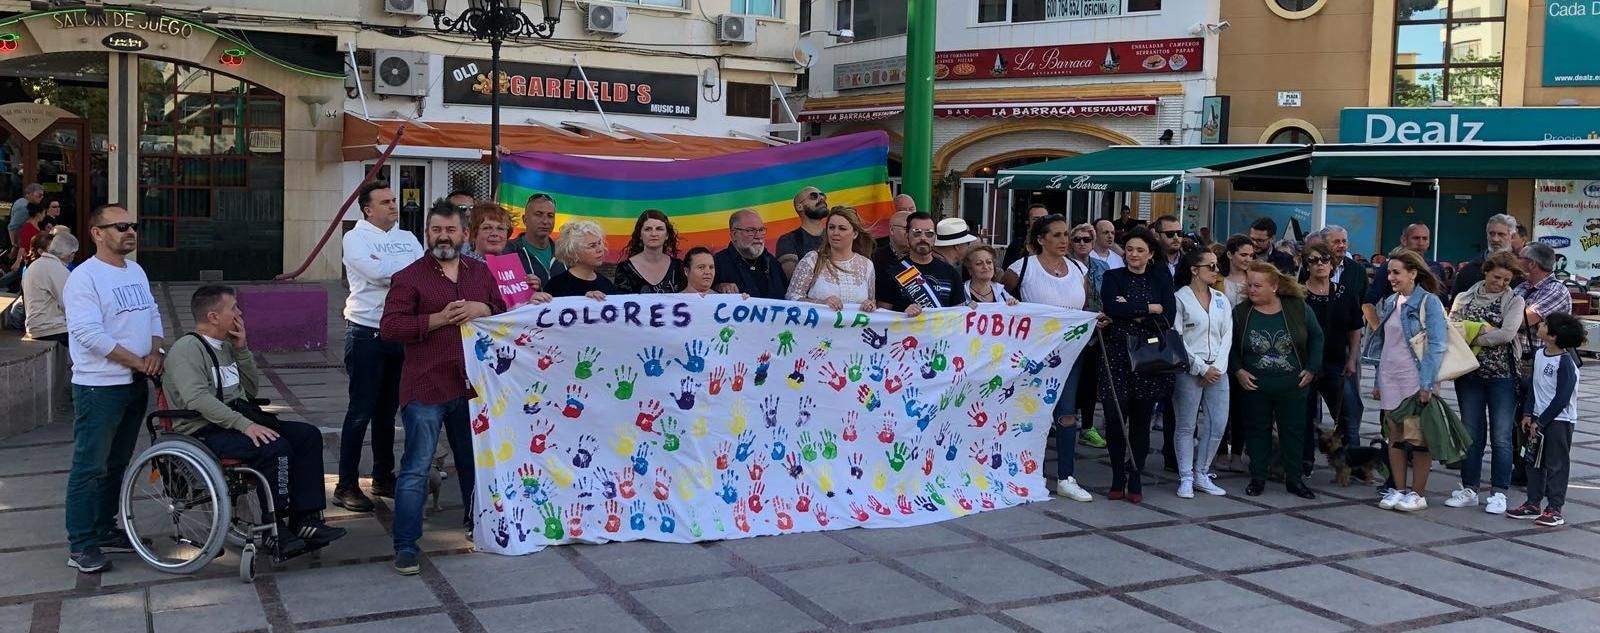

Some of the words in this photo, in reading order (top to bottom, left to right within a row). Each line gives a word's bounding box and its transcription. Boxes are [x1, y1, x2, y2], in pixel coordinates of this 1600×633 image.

[1083, 3, 1108, 16] OFICINA
[1549, 2, 1586, 17] Cada
[114, 12, 135, 28] DE
[139, 16, 193, 39] JUEGO
[1013, 48, 1035, 71] La
[1039, 47, 1095, 70] Barraca
[452, 62, 479, 83] OLD
[509, 75, 653, 104] GARFIELD'S
[650, 103, 674, 114] MUSIC
[675, 105, 690, 115] BAR
[839, 111, 872, 120] BARRACA
[992, 108, 1007, 116] LA
[1012, 106, 1076, 116] BARRACA
[1080, 104, 1150, 113] RESTAURANTE
[1366, 113, 1485, 143] Dealz
[1046, 174, 1068, 190] La
[1069, 175, 1108, 190] Barraca
[535, 300, 692, 328] COLORES
[713, 302, 819, 330] CONTRA
[833, 310, 871, 330] LA
